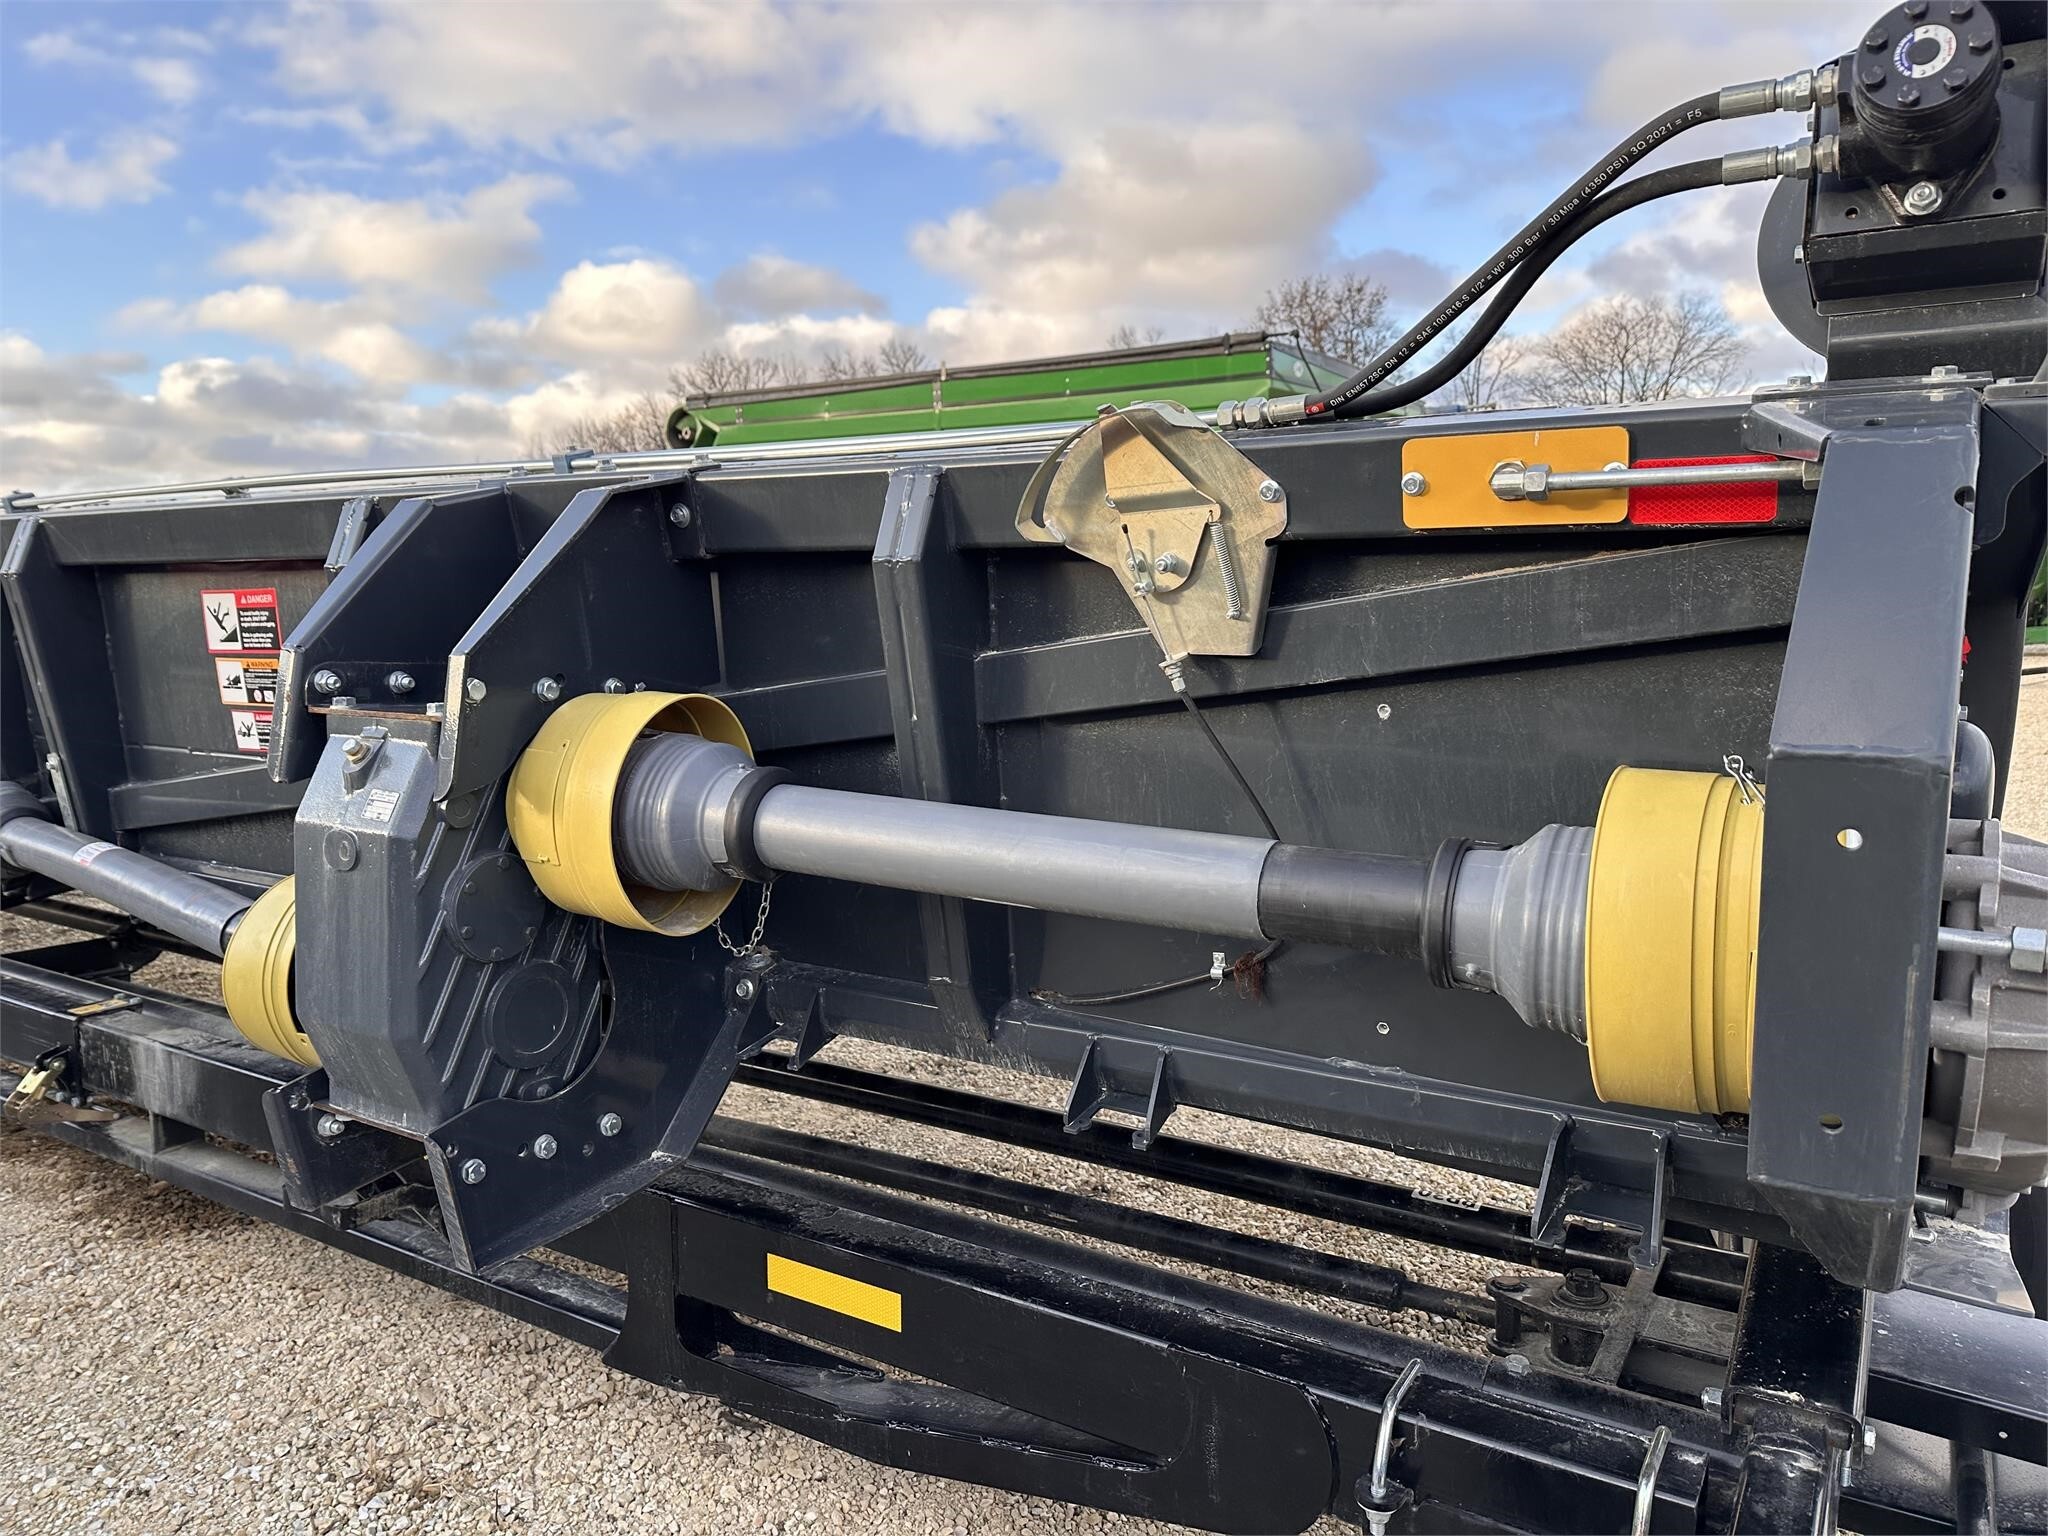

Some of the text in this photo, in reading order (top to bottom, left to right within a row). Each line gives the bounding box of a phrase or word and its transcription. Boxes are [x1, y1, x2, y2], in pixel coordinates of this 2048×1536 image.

[1330, 396, 1345, 407] DIN
[1345, 380, 1369, 398] EN857
[1368, 367, 1385, 382] 2SC
[1385, 356, 1398, 369] DN
[1398, 347, 1409, 358] 12
[1416, 327, 1433, 342] SAE
[1433, 314, 1447, 329] 100
[1446, 294, 1470, 316] R16-S
[1491, 261, 1506, 276] WP
[1507, 246, 1524, 262] 300
[1524, 231, 1541, 246] Bar
[1548, 214, 1561, 226] 30
[1560, 198, 1580, 216] Mpa
[1580, 173, 1607, 198] (4350
[1606, 155, 1629, 175] PSI)
[1630, 141, 1647, 155] 3Q
[1646, 122, 1673, 143] 2021
[246, 594, 272, 603] DANGER
